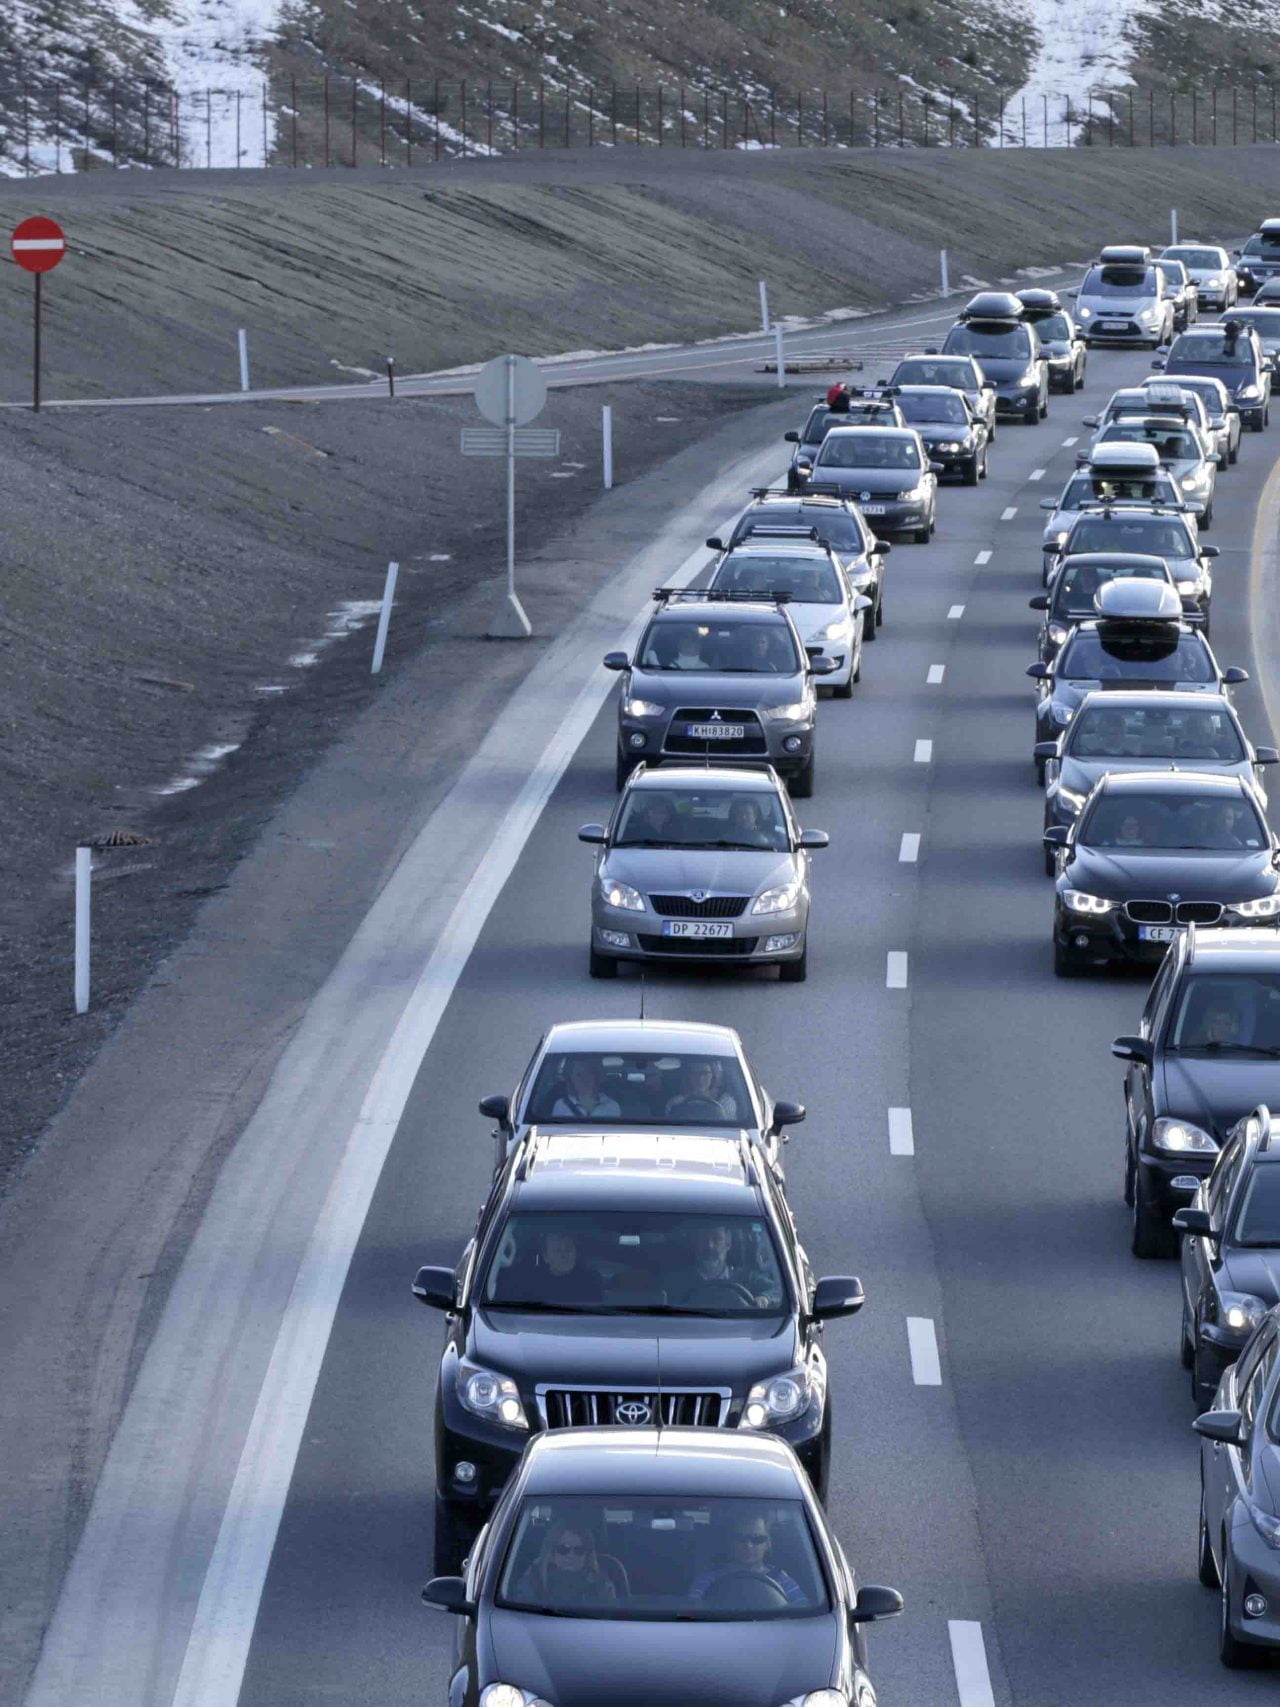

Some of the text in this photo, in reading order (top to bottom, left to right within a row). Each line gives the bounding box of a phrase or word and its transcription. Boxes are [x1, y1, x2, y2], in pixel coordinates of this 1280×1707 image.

[694, 726, 743, 737] KH 83820
[673, 923, 729, 936] DP 22677
[1150, 928, 1164, 939] CF
